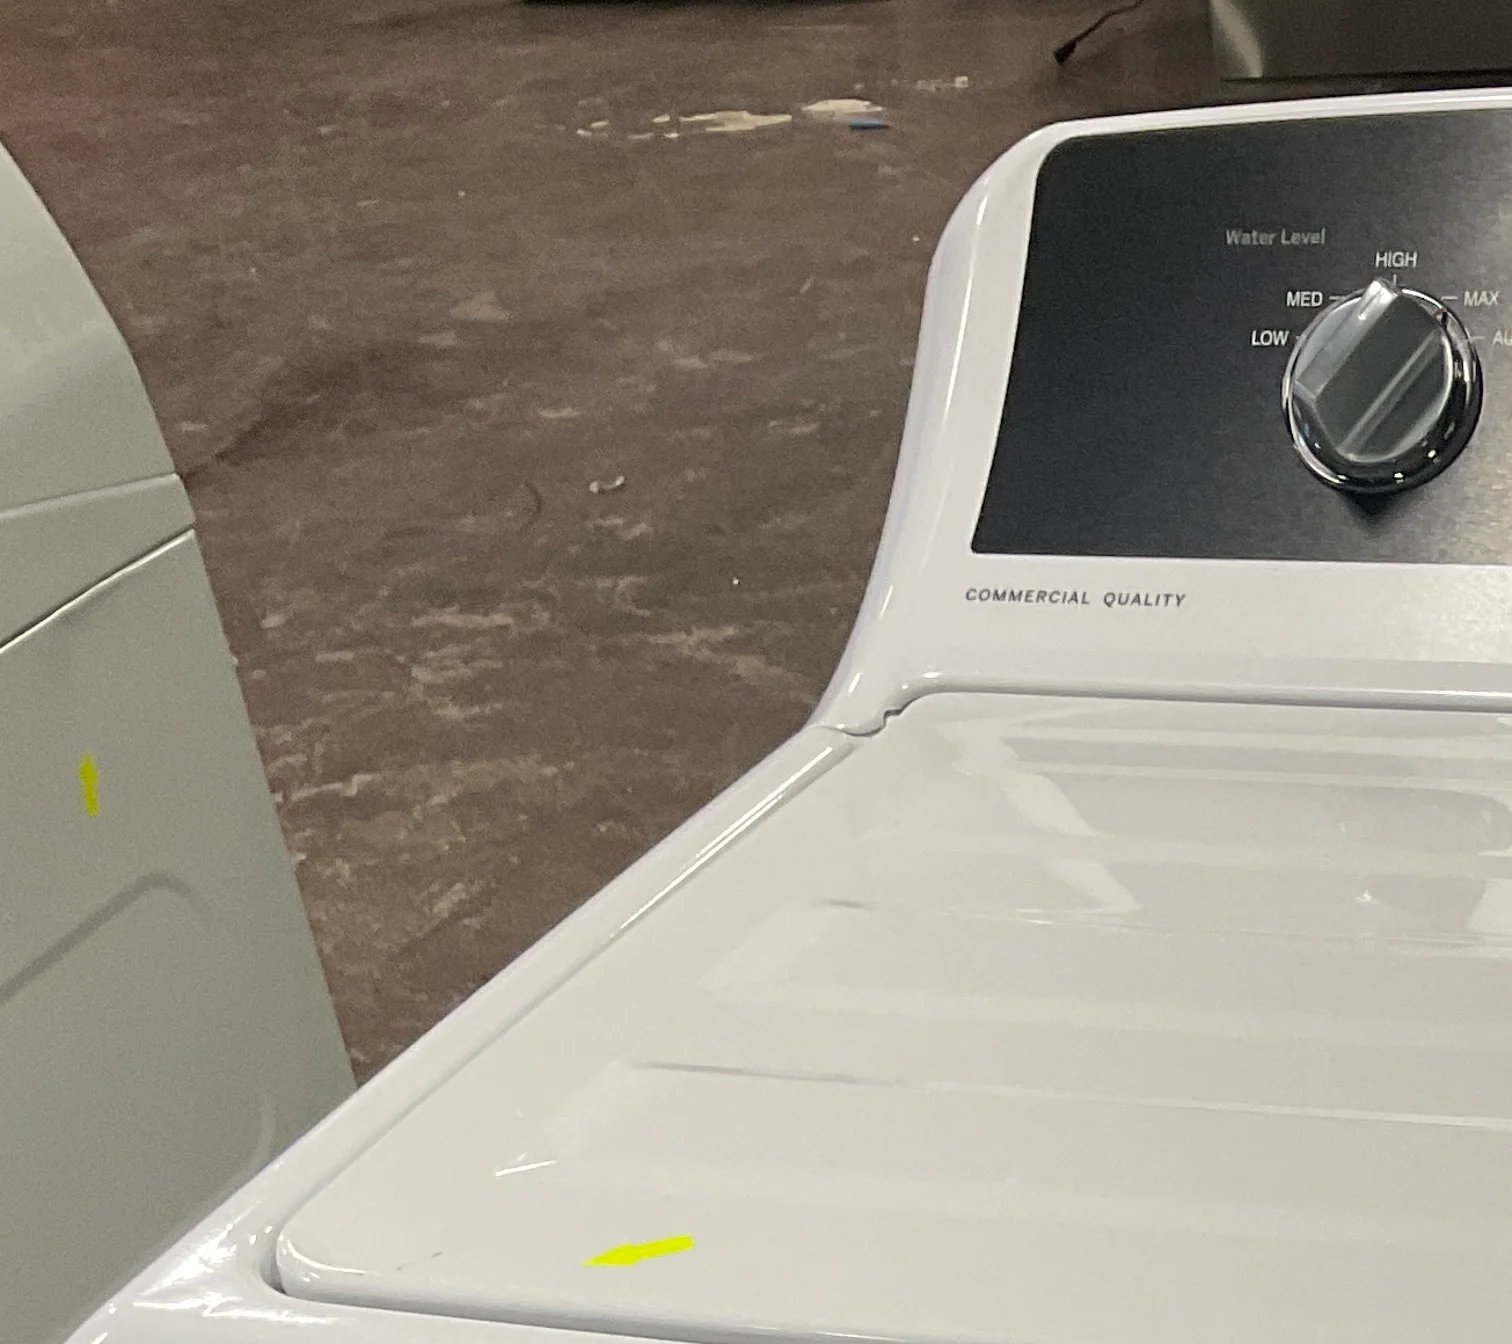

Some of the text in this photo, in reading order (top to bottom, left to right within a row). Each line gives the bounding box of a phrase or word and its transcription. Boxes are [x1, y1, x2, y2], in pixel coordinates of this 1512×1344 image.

[1226, 228, 1326, 245] Water Level
[1375, 251, 1418, 268] HIGH
[1286, 291, 1323, 307] MED
[1464, 291, 1500, 306] MAX
[1251, 330, 1290, 346] LOW
[965, 588, 1186, 608] COMMERCIAL QUALITY
